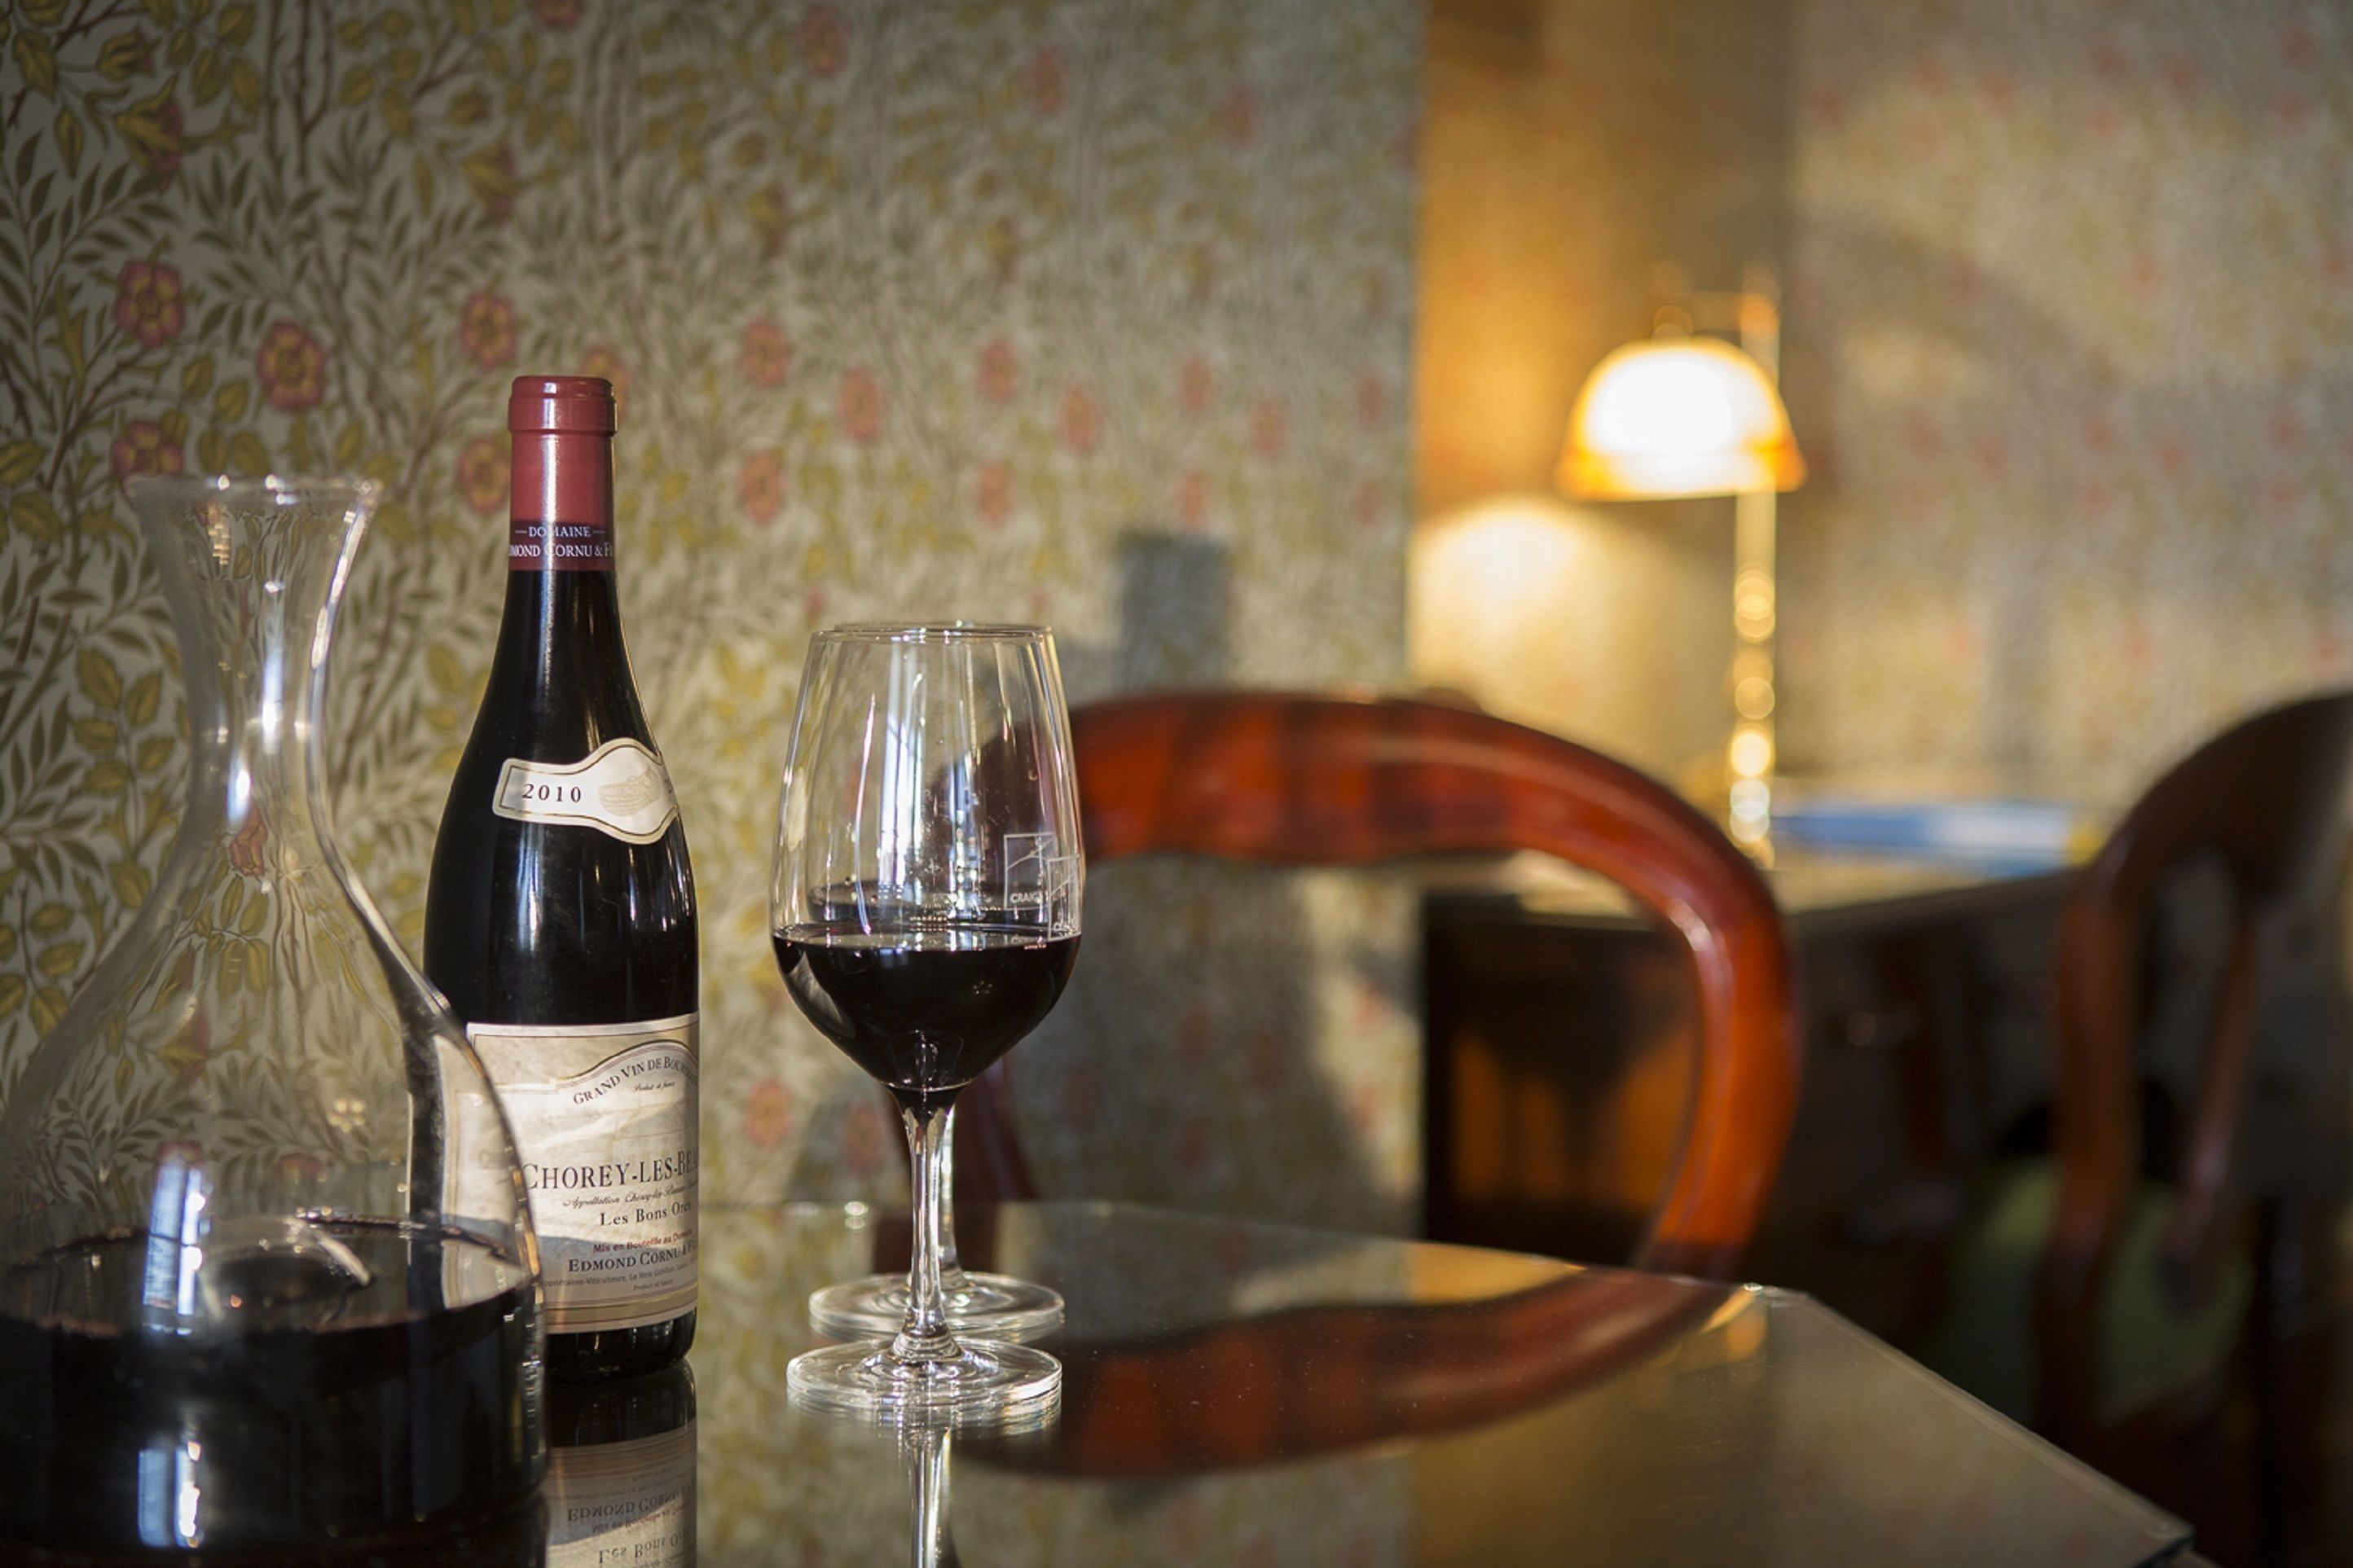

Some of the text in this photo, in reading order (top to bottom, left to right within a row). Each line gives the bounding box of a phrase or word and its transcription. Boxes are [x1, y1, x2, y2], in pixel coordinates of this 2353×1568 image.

[595, 545, 603, 557] &
[521, 784, 581, 803] 2010
[573, 1075, 621, 1105] GRAND
[621, 1061, 645, 1078] VIN
[647, 1057, 662, 1070] DE
[563, 1195, 620, 1209] Appellation
[600, 1212, 628, 1227] Les
[636, 1207, 667, 1223] Bons
[593, 1244, 610, 1254] Mis
[569, 1256, 636, 1272] EDMOND
[640, 1247, 680, 1266] CORNU
